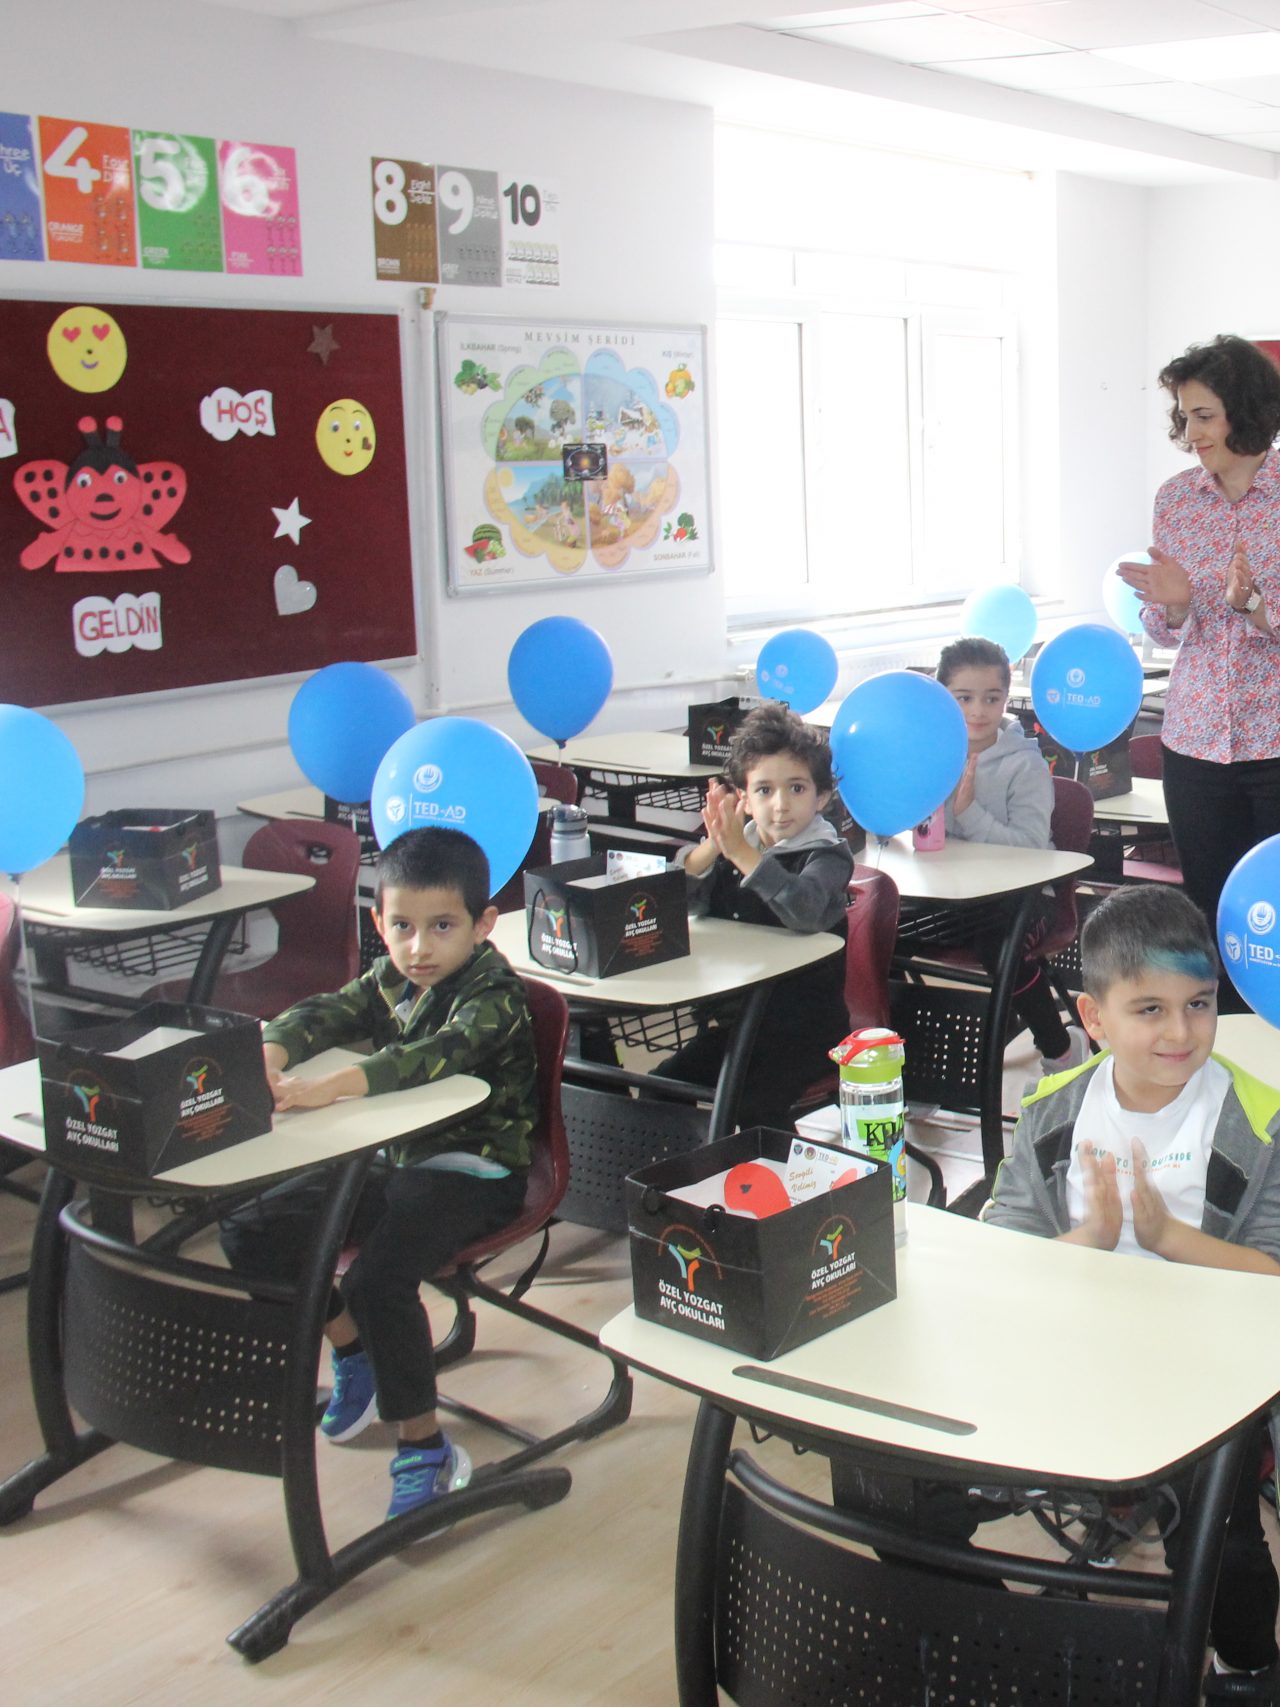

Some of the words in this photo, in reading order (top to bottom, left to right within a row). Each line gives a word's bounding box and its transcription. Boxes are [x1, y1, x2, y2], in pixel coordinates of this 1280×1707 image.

[44, 127, 101, 193] 4
[140, 138, 186, 213] 5
[223, 147, 270, 215] 6
[374, 160, 408, 226] 8
[410, 179, 432, 192] Eight
[438, 170, 474, 235] 9
[503, 181, 541, 227] 10
[524, 331, 580, 343] MEVSİM
[588, 333, 636, 346] ŞERİDİ
[216, 396, 268, 428] HOŞ
[78, 602, 160, 642] GELDİN
[552, 947, 579, 960] OKULLAI
[65, 1115, 87, 1132] ÖZEL
[86, 1122, 118, 1139] YOZGAT
[66, 1130, 82, 1145] AYÇ
[82, 1134, 119, 1153] OKULLARI
[811, 1267, 829, 1280] ÖZEL
[829, 1251, 856, 1271] YOZGAT
[811, 1277, 826, 1290] AYÇ
[825, 1261, 857, 1283] OKULLARI
[658, 1278, 682, 1301] ÖZEL
[683, 1291, 724, 1316] YOZGAT
[660, 1295, 677, 1315] AYÇ
[678, 1303, 725, 1331] OKULLARI
